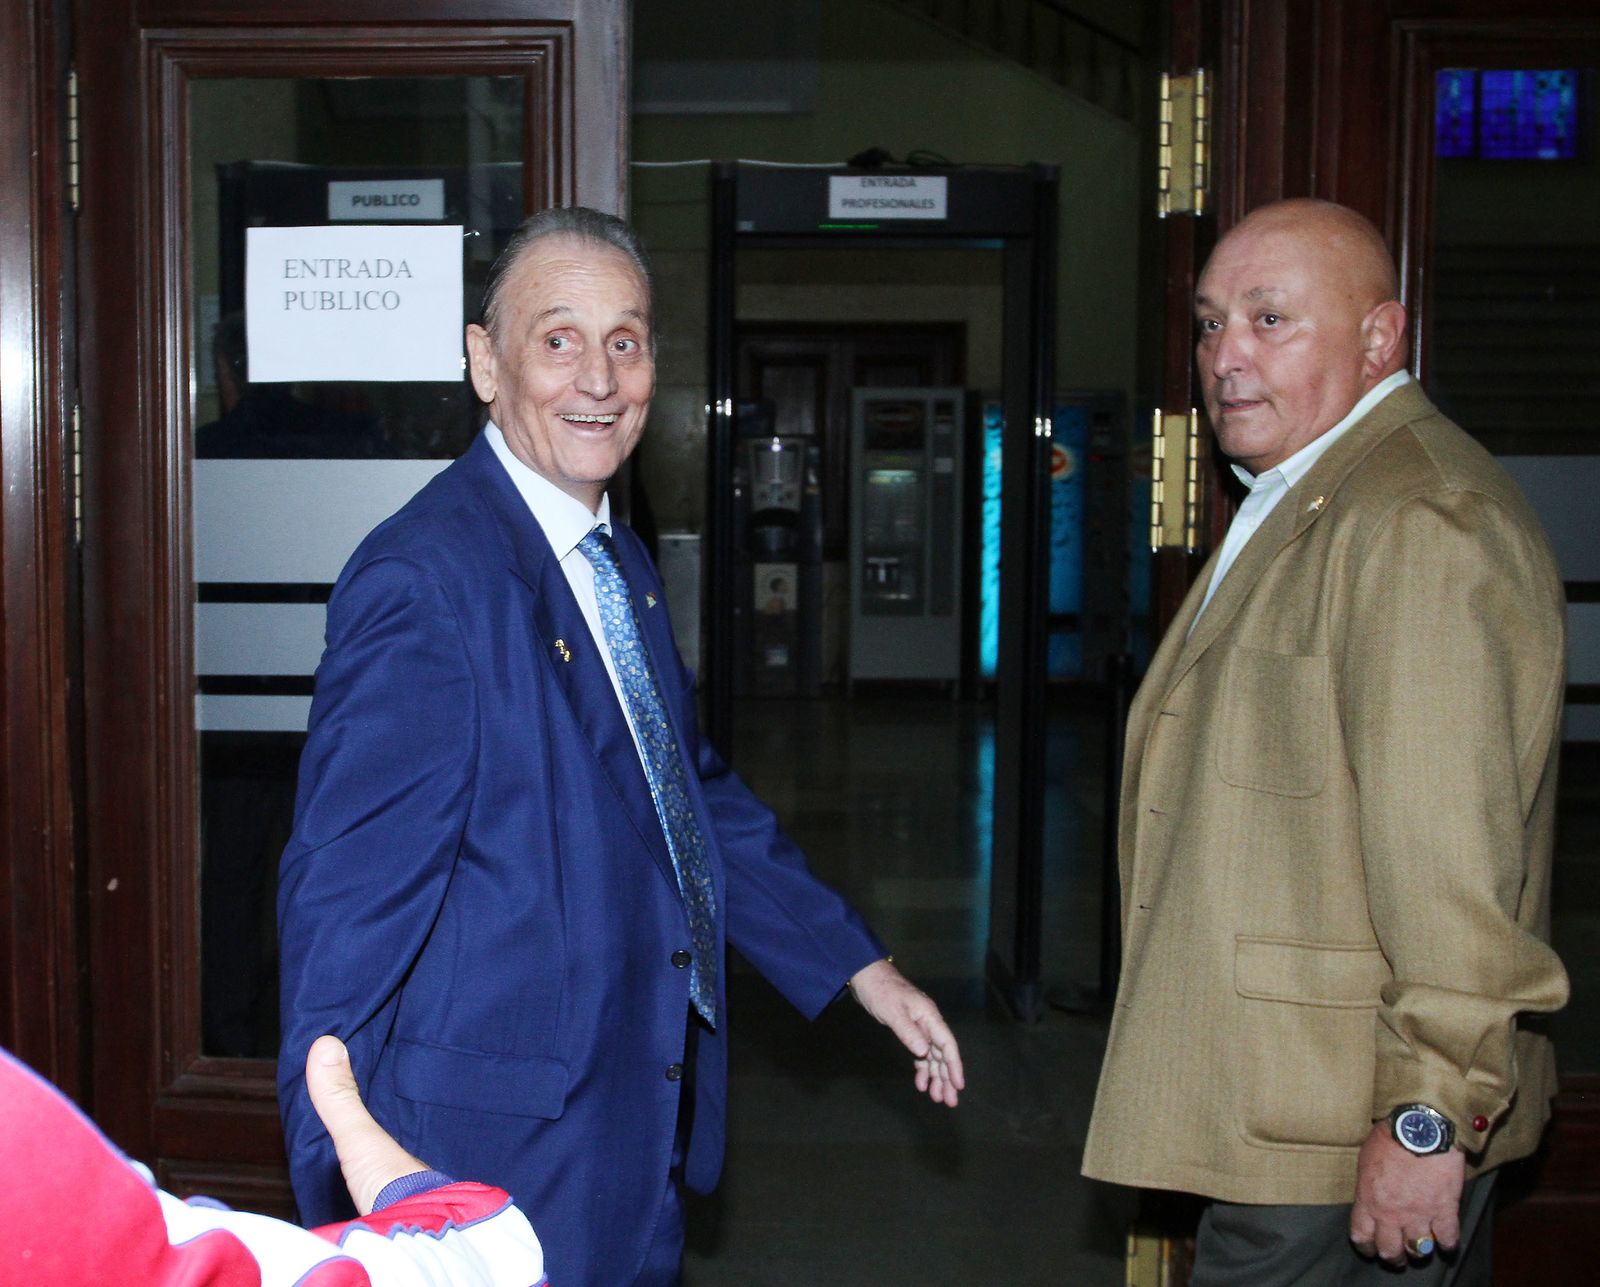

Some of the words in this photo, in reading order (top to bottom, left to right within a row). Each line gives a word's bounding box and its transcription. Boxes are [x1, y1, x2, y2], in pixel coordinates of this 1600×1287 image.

[861, 177, 917, 187] ENTRADA
[352, 194, 420, 207] PUBLICO
[841, 198, 936, 209] PROFESIONALES
[284, 259, 413, 279] ENTRADA
[284, 290, 400, 311] PUBLICO
